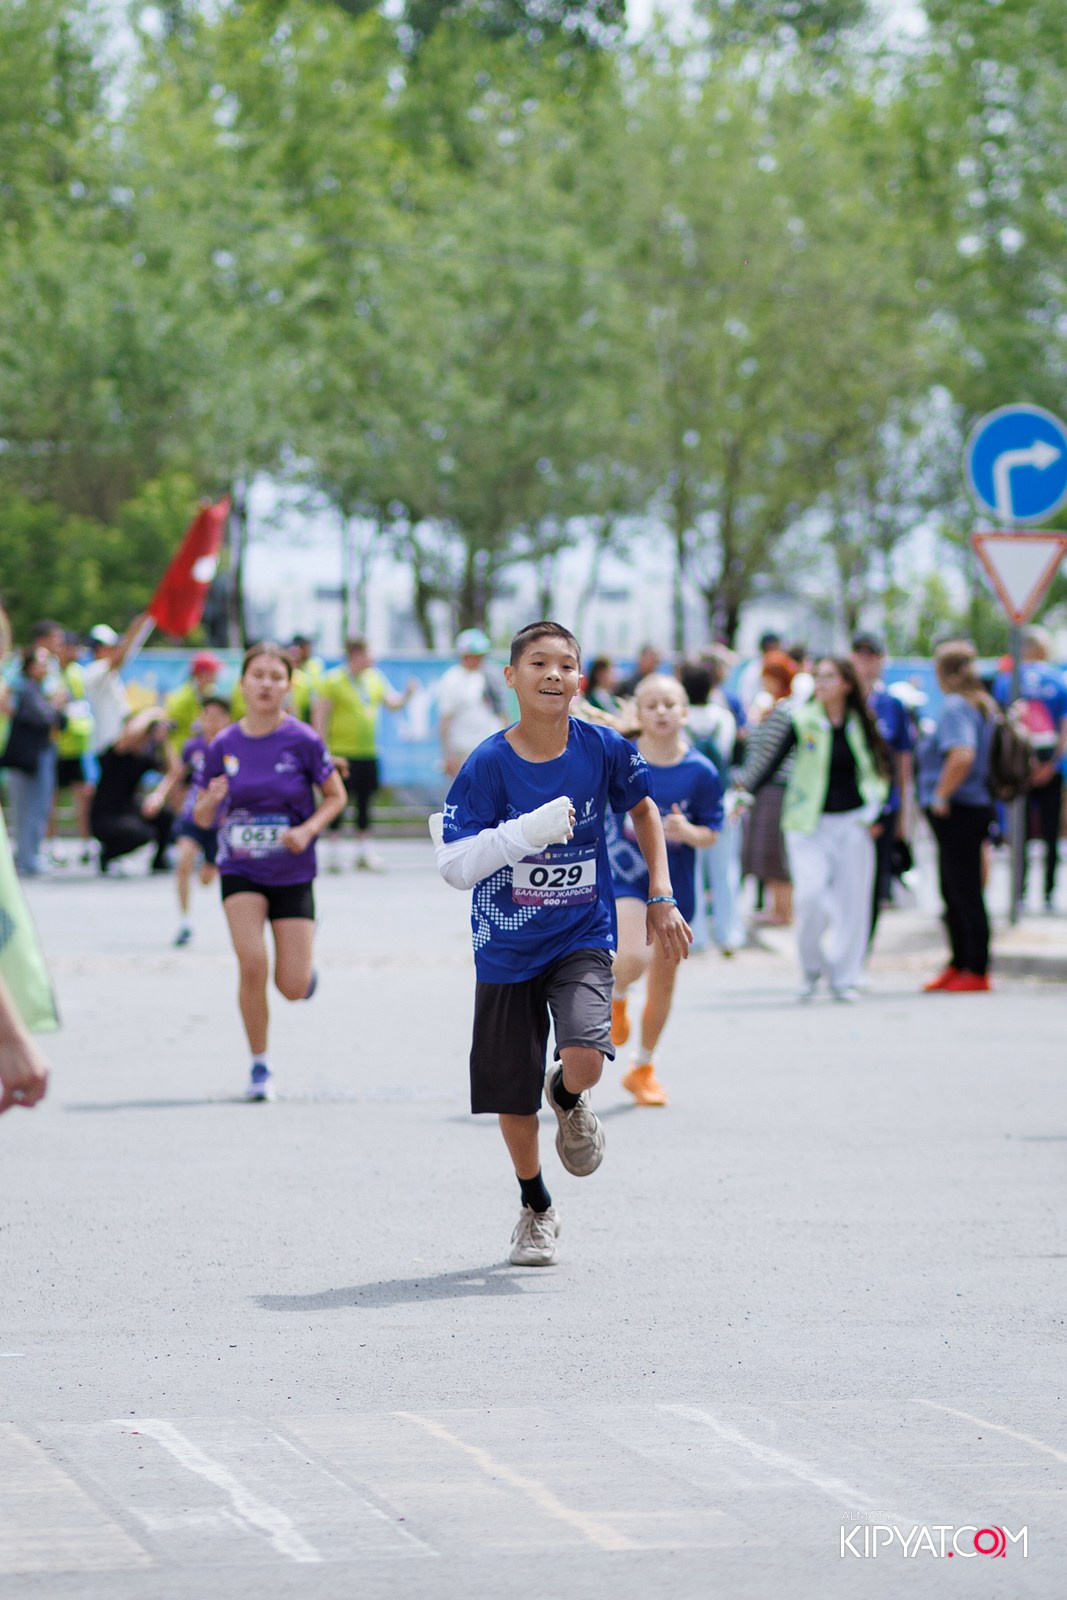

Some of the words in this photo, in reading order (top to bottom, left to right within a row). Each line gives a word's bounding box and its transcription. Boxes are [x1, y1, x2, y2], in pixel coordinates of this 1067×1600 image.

[529, 865, 582, 887] 029
[515, 889, 555, 898] БАЛАЛАР
[556, 886, 593, 898] ЖАРЫСЫ
